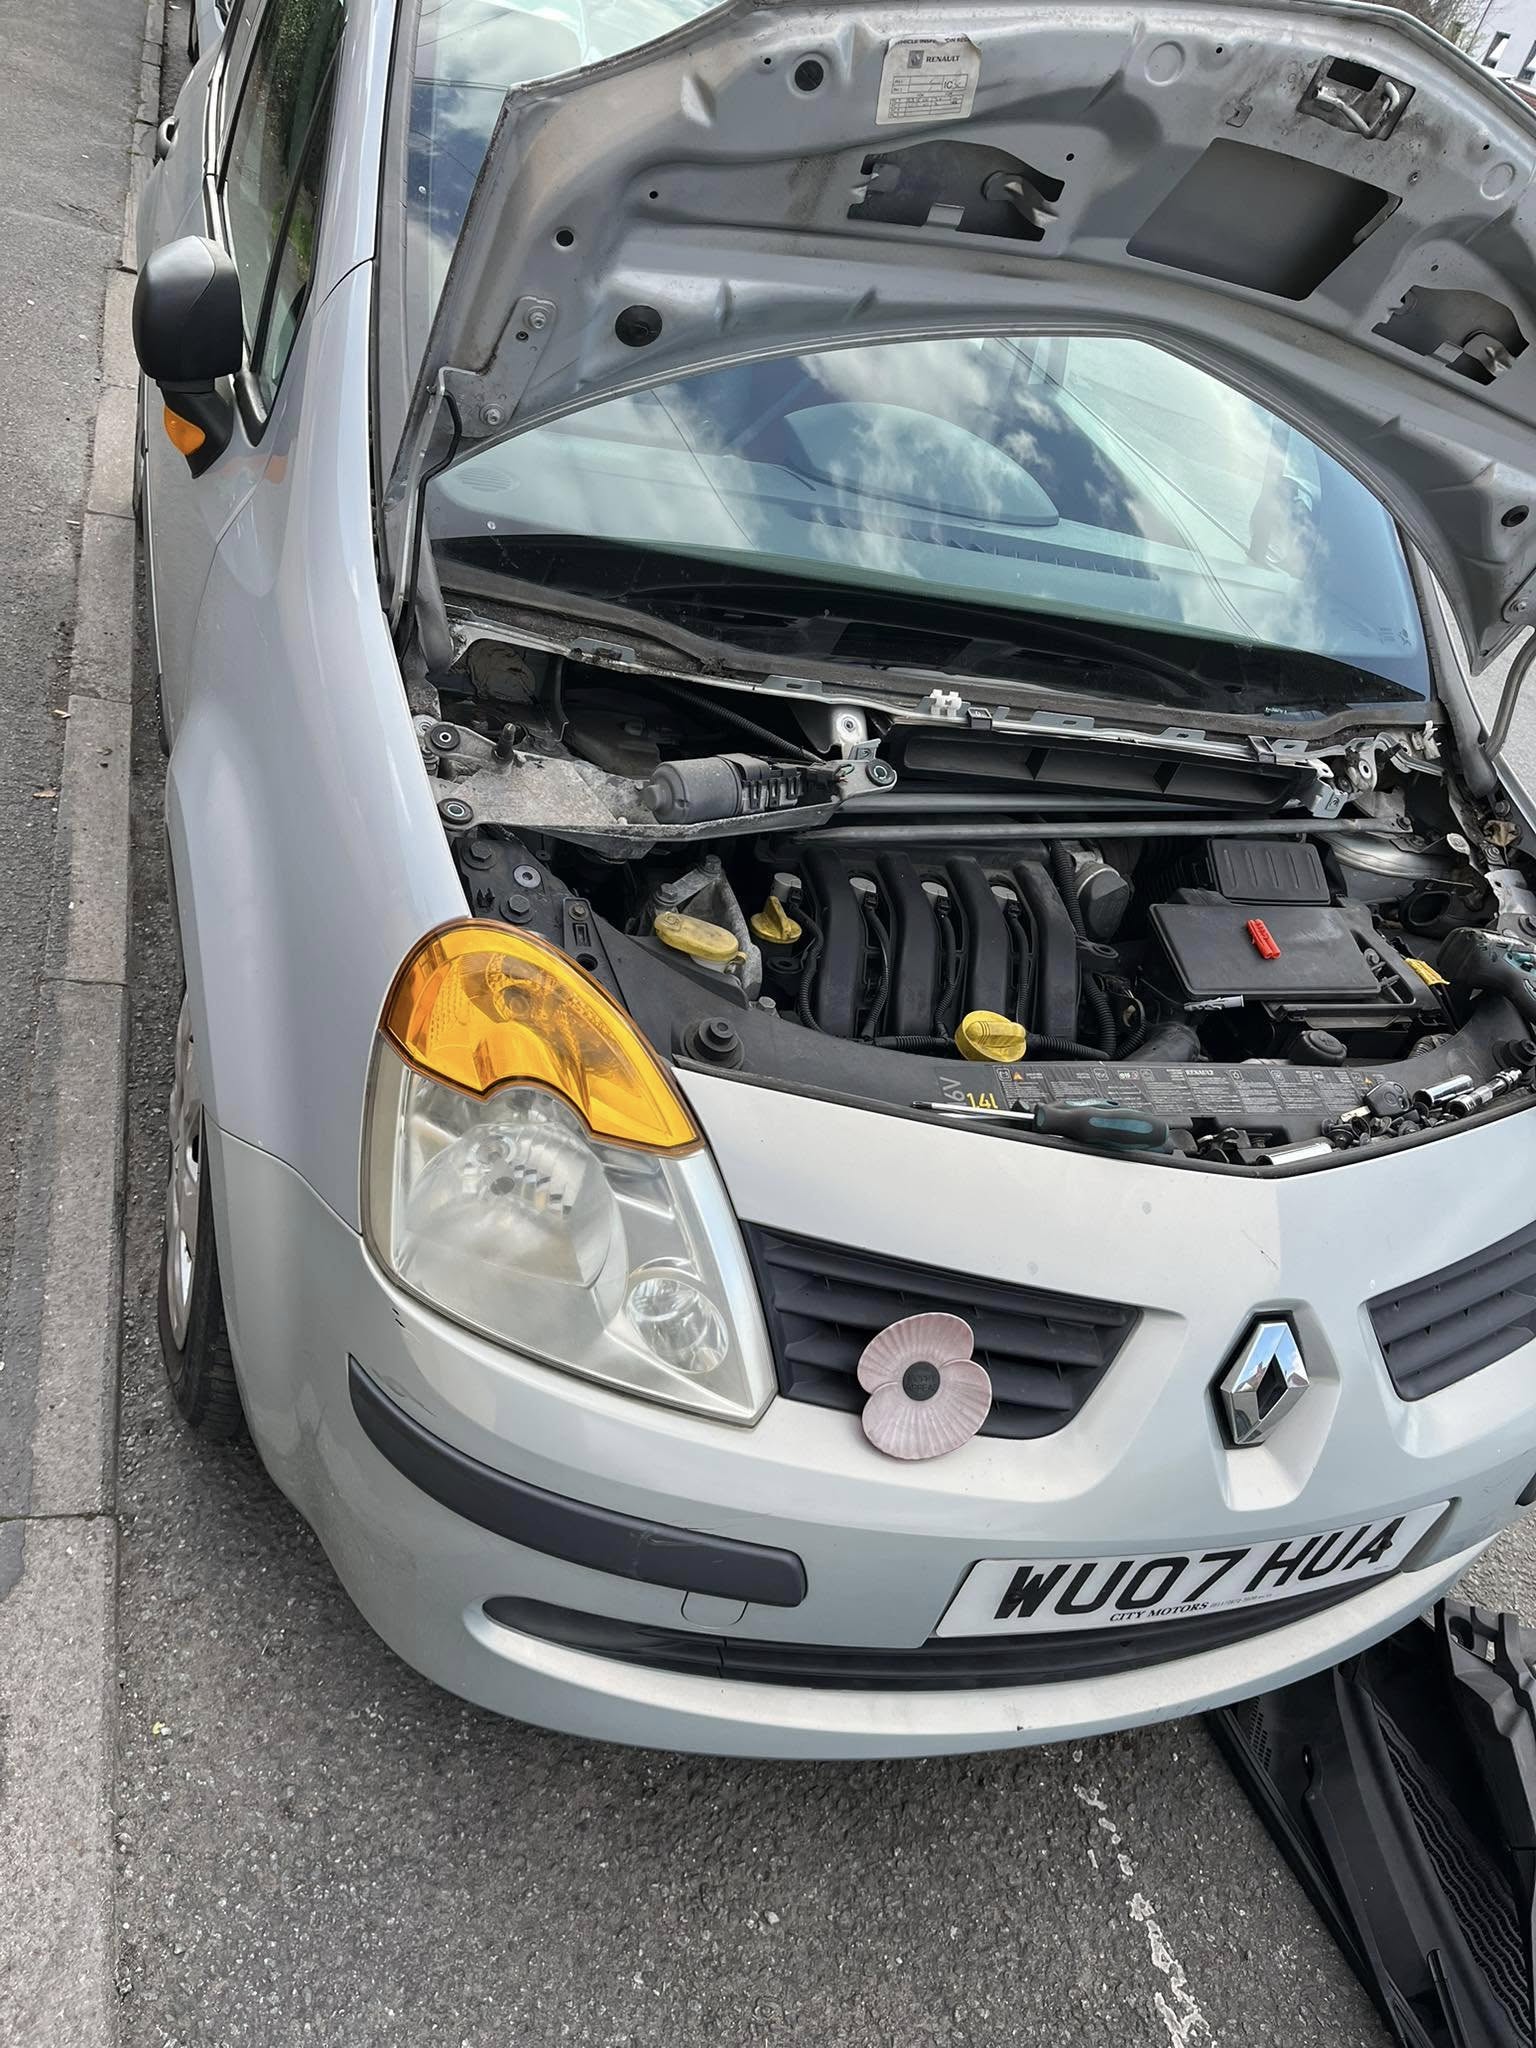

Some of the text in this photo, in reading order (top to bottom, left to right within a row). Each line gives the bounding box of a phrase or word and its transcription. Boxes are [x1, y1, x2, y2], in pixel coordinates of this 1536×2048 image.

[926, 55, 960, 63] RENAULT
[993, 1516, 1406, 1620] WU07 HUA
[1109, 1610, 1146, 1622] CITY
[1147, 1601, 1210, 1618] MOTORS
